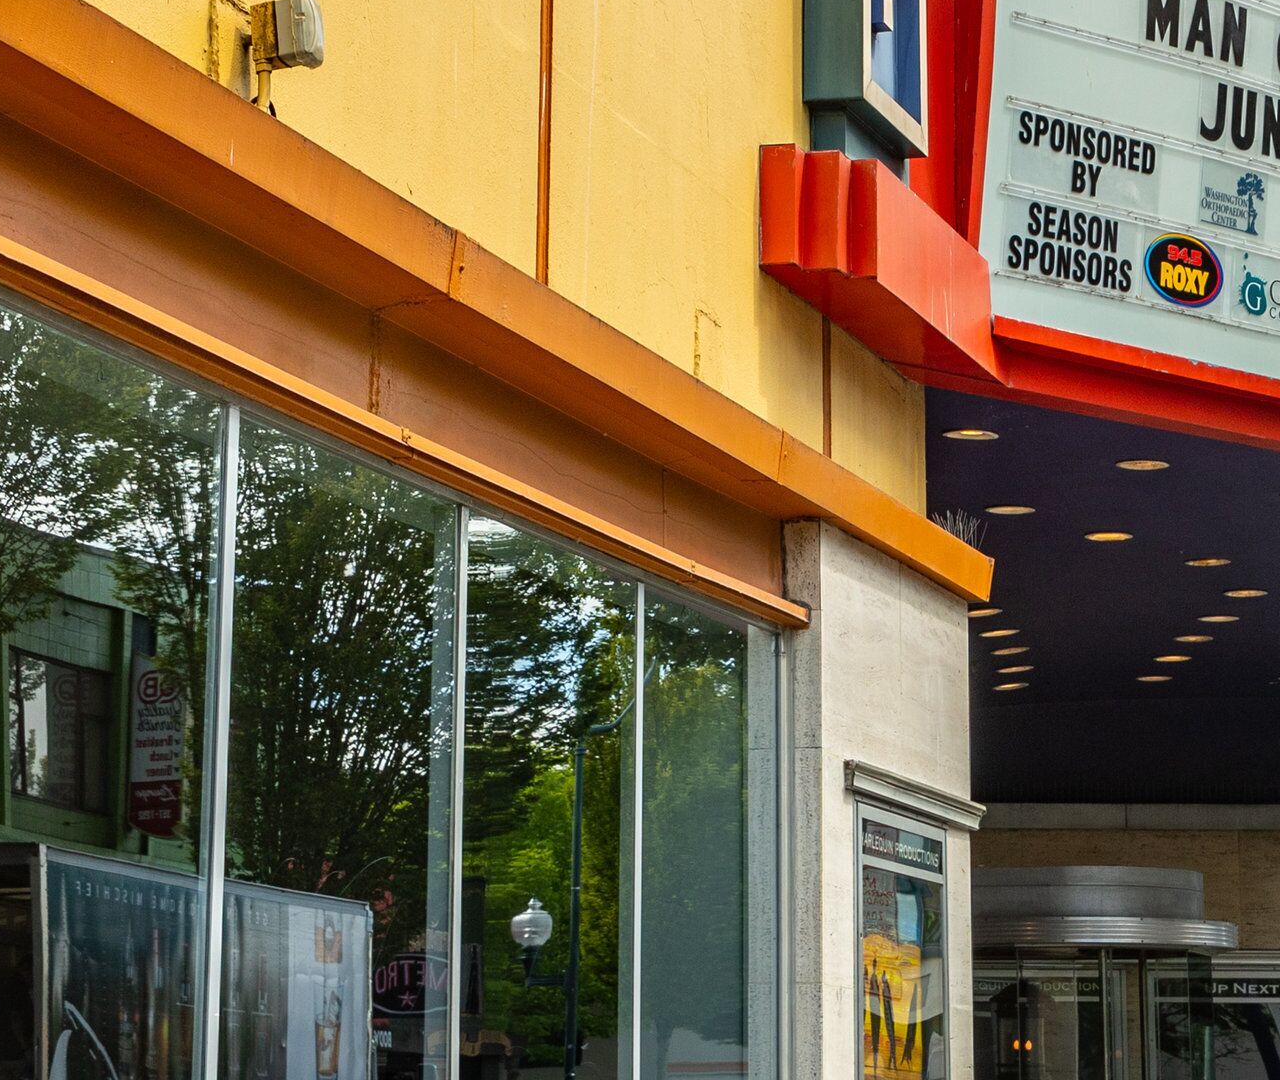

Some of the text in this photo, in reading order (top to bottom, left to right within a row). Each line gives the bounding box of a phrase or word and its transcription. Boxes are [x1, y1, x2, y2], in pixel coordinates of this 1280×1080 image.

[1018, 110, 1156, 175] SPONSORED
[1071, 159, 1102, 197] BY
[1027, 202, 1119, 254] SEASON
[1007, 234, 1133, 293] SPONSORS
[1167, 244, 1203, 266] 94.5
[1160, 261, 1210, 297] ROXY
[1245, 282, 1262, 311] G
[863, 831, 939, 867] ARLEQUIN PRODUCTIONS
